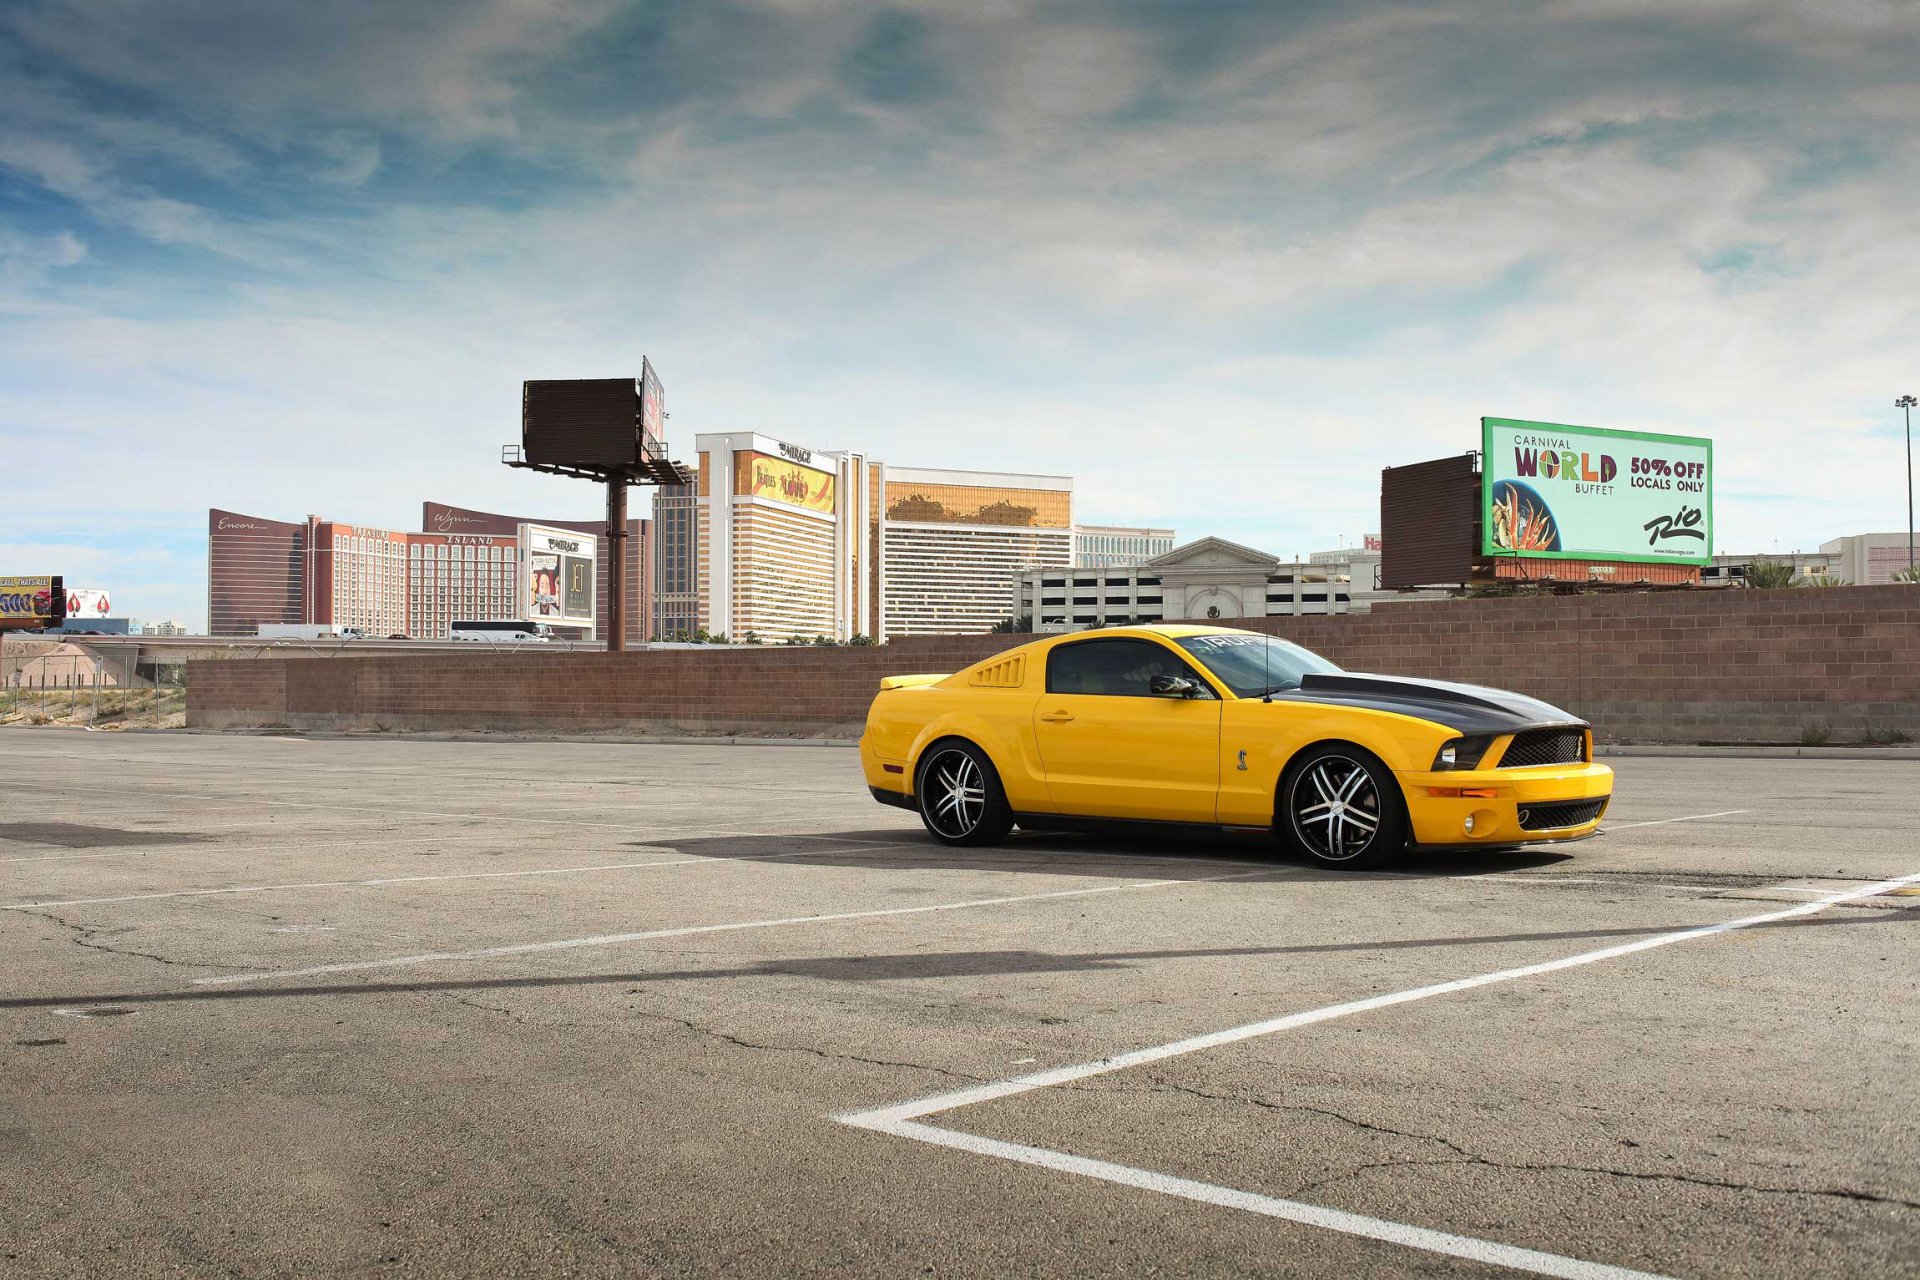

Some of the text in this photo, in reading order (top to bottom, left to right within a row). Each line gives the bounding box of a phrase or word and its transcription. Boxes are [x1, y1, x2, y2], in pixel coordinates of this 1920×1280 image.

[1514, 435, 1571, 449] CARNIVAL
[781, 445, 812, 464] MIRAGE
[1514, 447, 1617, 483] WORLD
[1631, 457, 1705, 479] 50% OFF
[1575, 483, 1615, 495] BUFFET
[1631, 476, 1705, 492] LOCALS ONLY
[218, 517, 268, 530] Encore
[434, 509, 487, 531] Wynn
[1643, 505, 1705, 546] Rio
[447, 536, 493, 545] ISLAND
